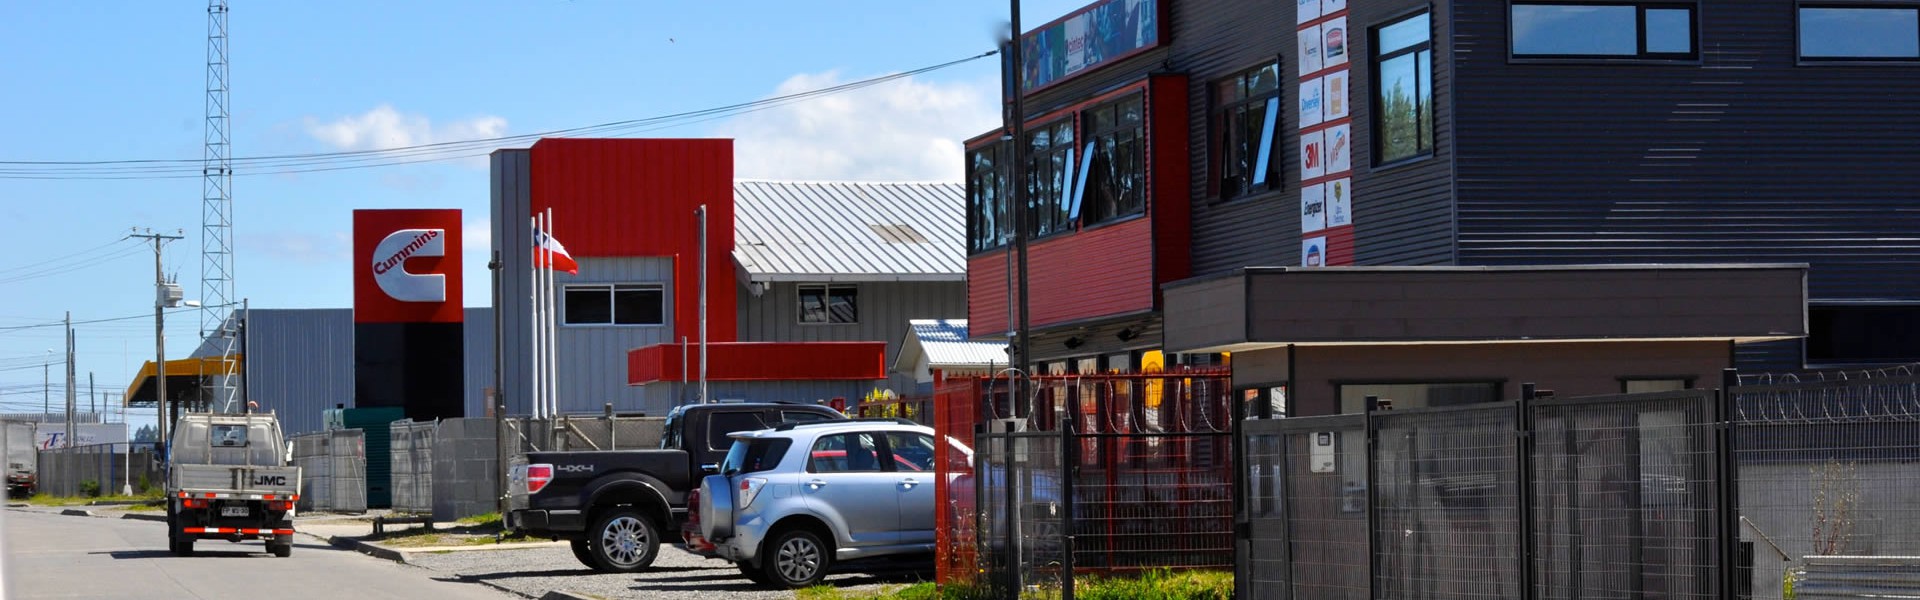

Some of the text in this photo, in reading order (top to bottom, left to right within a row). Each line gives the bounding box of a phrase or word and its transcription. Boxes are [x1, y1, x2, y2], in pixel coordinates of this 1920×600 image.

[1302, 97, 1320, 112] Diversey
[1305, 141, 1319, 169] 3M
[1304, 201, 1323, 218] Energizer
[374, 230, 438, 275] Cummins
[255, 475, 286, 486] JMC
